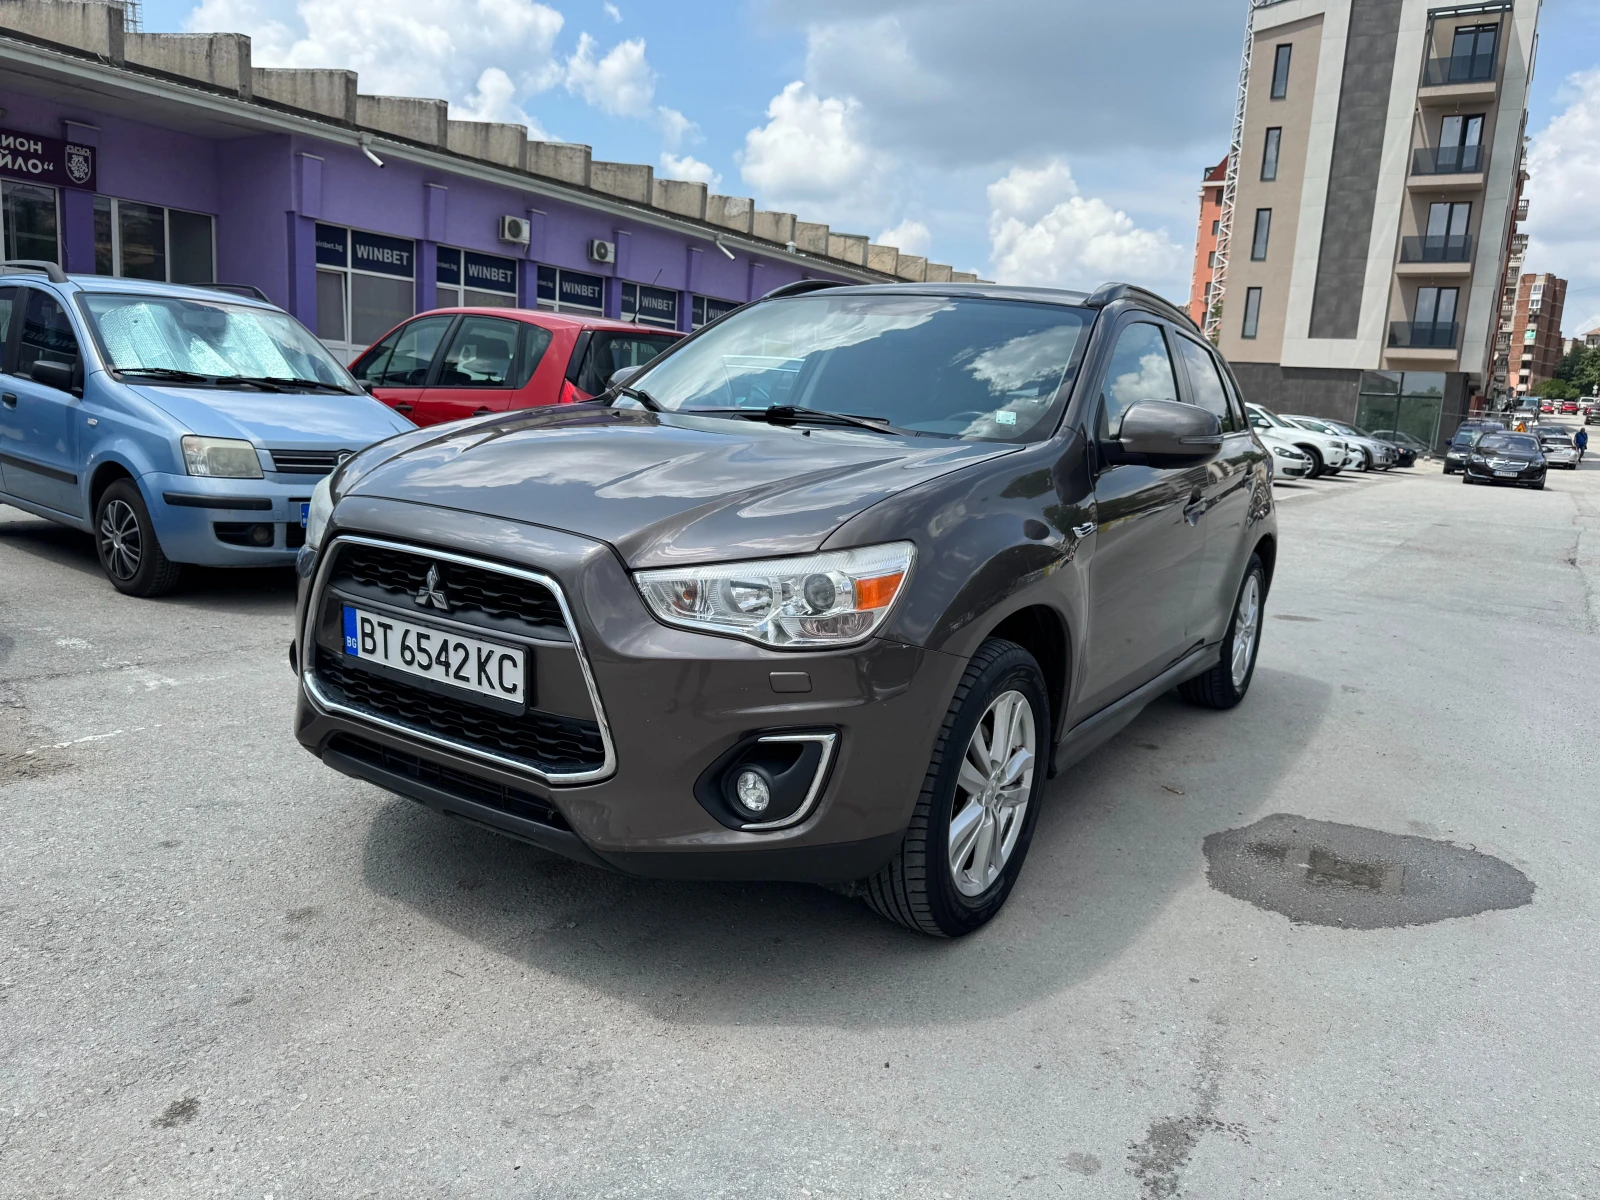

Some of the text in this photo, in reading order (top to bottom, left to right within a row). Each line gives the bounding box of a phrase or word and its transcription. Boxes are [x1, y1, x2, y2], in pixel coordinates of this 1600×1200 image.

[0, 134, 42, 154] ИОН
[0, 149, 54, 174] ЙЛО“
[356, 244, 410, 266] WINBET
[467, 263, 513, 283] WINBET
[562, 281, 600, 299] WINBET
[641, 295, 674, 312] WINBET
[347, 636, 357, 649] BG
[361, 616, 518, 695] BT 6542 KC
